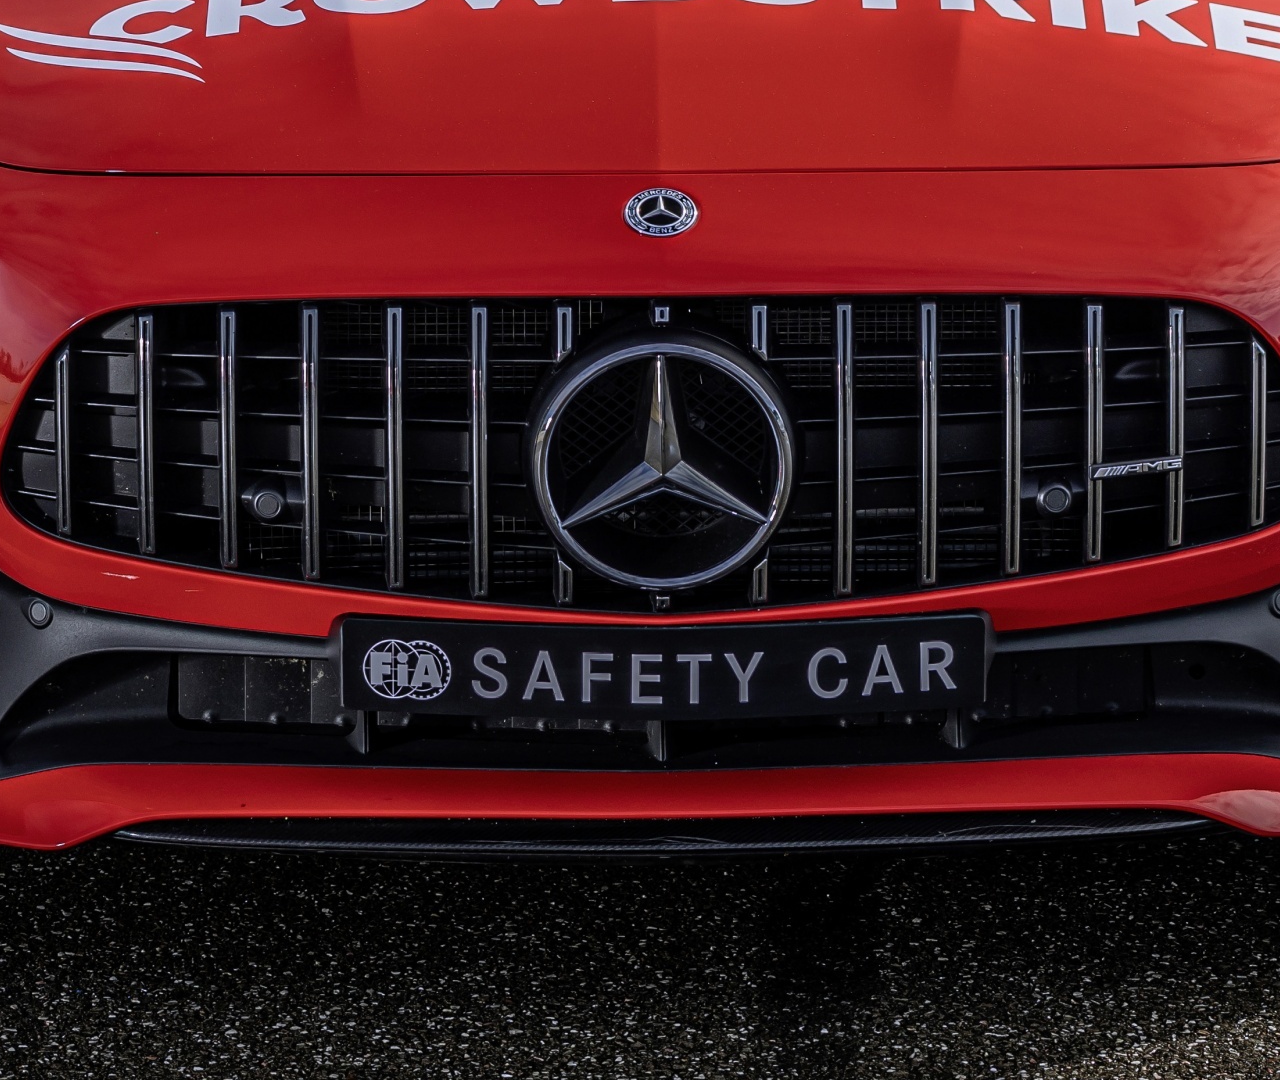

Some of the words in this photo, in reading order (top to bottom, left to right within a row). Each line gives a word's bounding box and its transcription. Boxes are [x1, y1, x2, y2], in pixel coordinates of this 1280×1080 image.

[638, 190, 684, 200] MERCEDES
[471, 647, 765, 705] SAFETY
[807, 640, 958, 699] CAR
